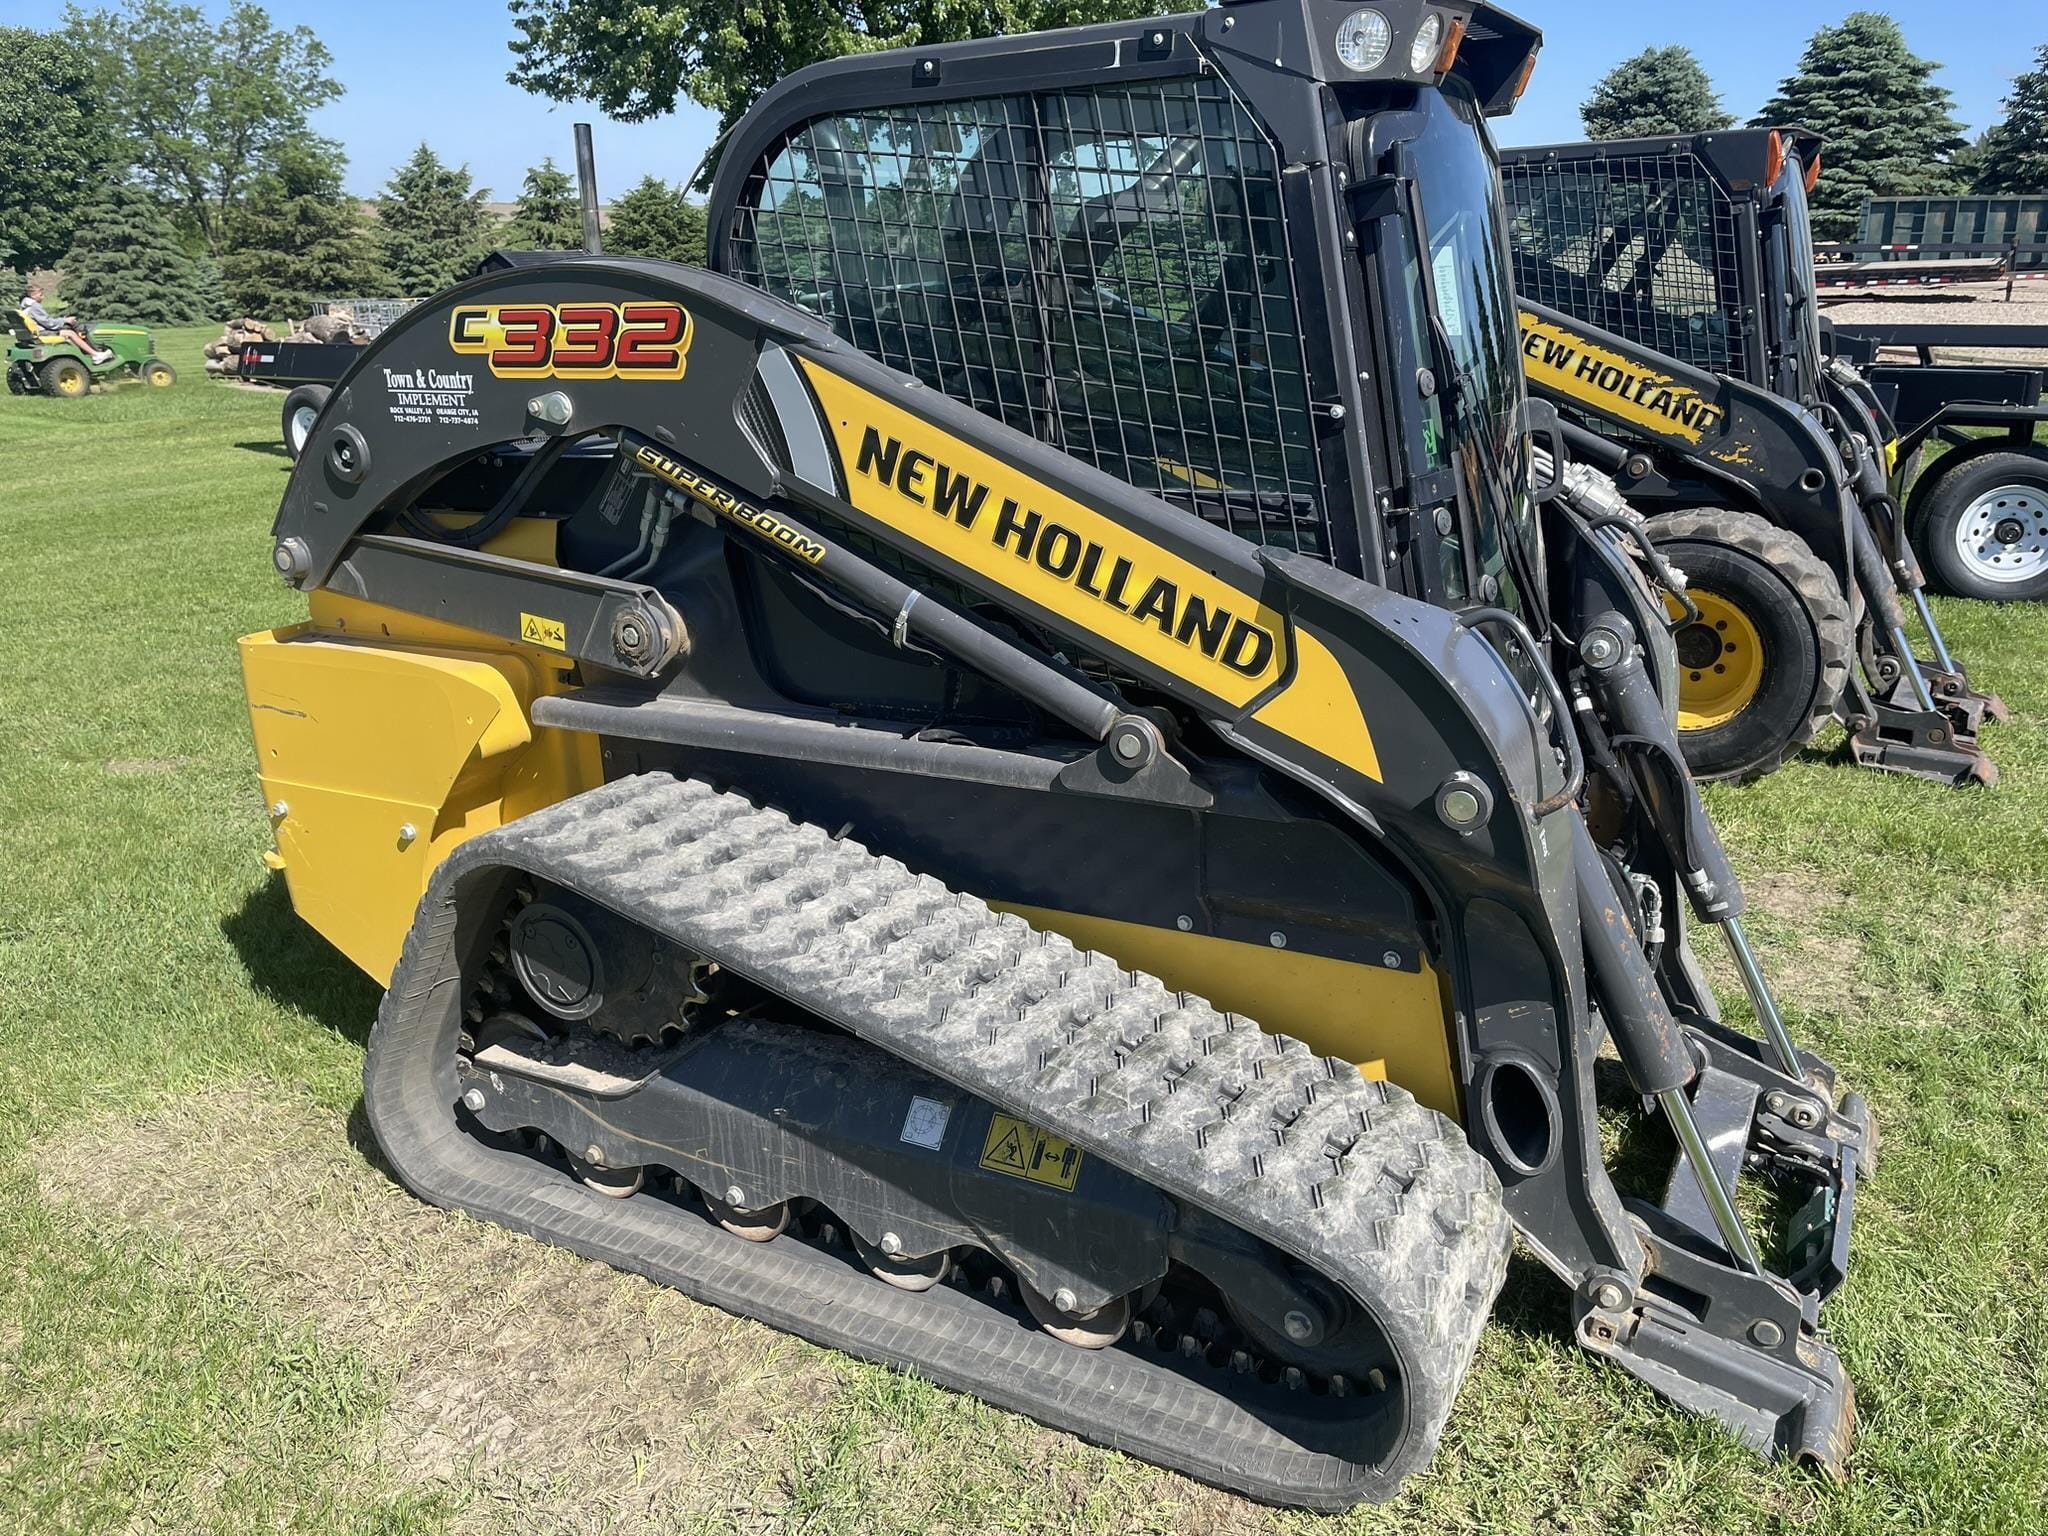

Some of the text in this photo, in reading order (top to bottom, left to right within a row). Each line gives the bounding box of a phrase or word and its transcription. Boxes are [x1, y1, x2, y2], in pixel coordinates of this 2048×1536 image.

[452, 304, 690, 373] C332
[1520, 327, 1577, 371] EW
[383, 368, 473, 395] Town & Country
[389, 406, 404, 414] ROCK
[397, 393, 466, 407] IMPLEMENT
[435, 408, 457, 416] ORANGE
[637, 446, 735, 513] SUPER
[733, 501, 826, 564] BOOM
[855, 423, 1275, 680] NEW HOLLAND
